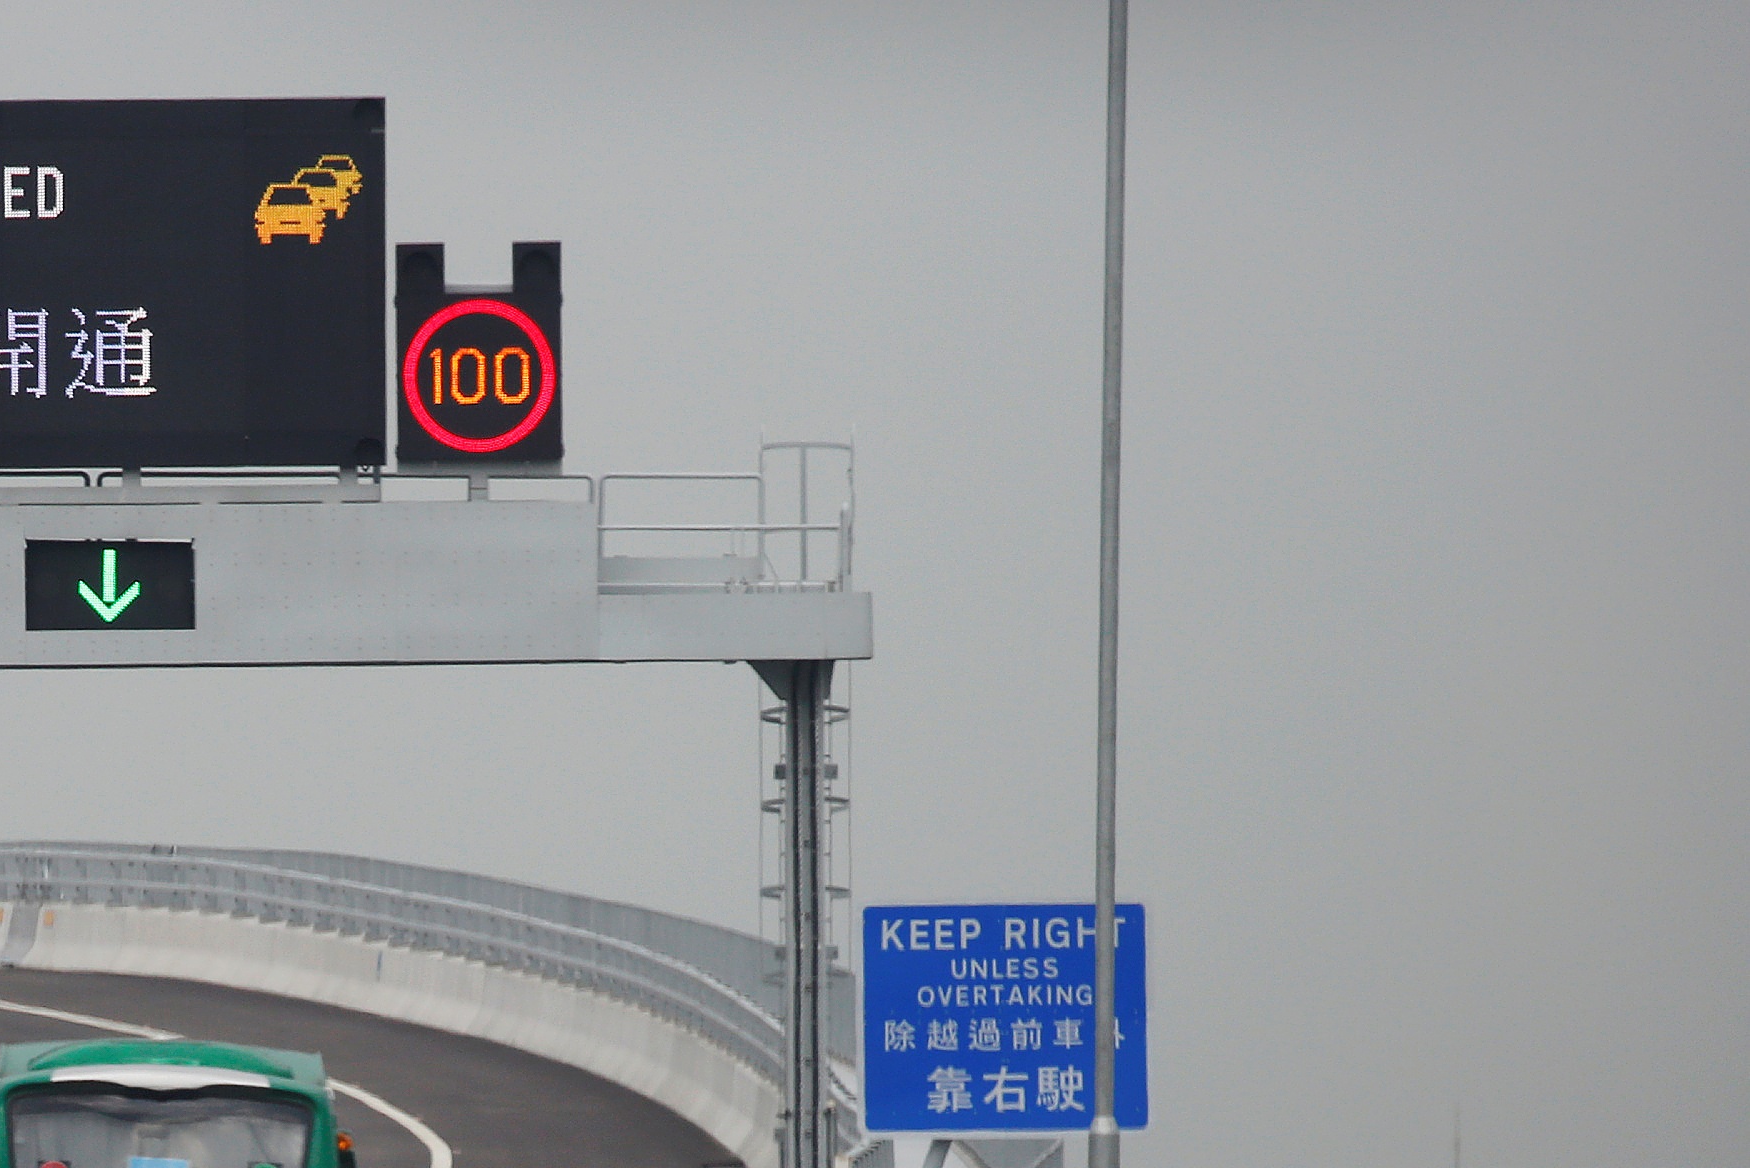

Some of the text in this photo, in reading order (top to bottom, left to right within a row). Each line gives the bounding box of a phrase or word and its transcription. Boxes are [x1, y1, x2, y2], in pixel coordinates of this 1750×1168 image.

[429, 346, 532, 405] 100
[881, 917, 982, 951] KEEP
[951, 957, 1059, 980] UNLESS
[917, 984, 1093, 1008] OVERTAKING
[927, 1064, 1086, 1113] 靠右駛
